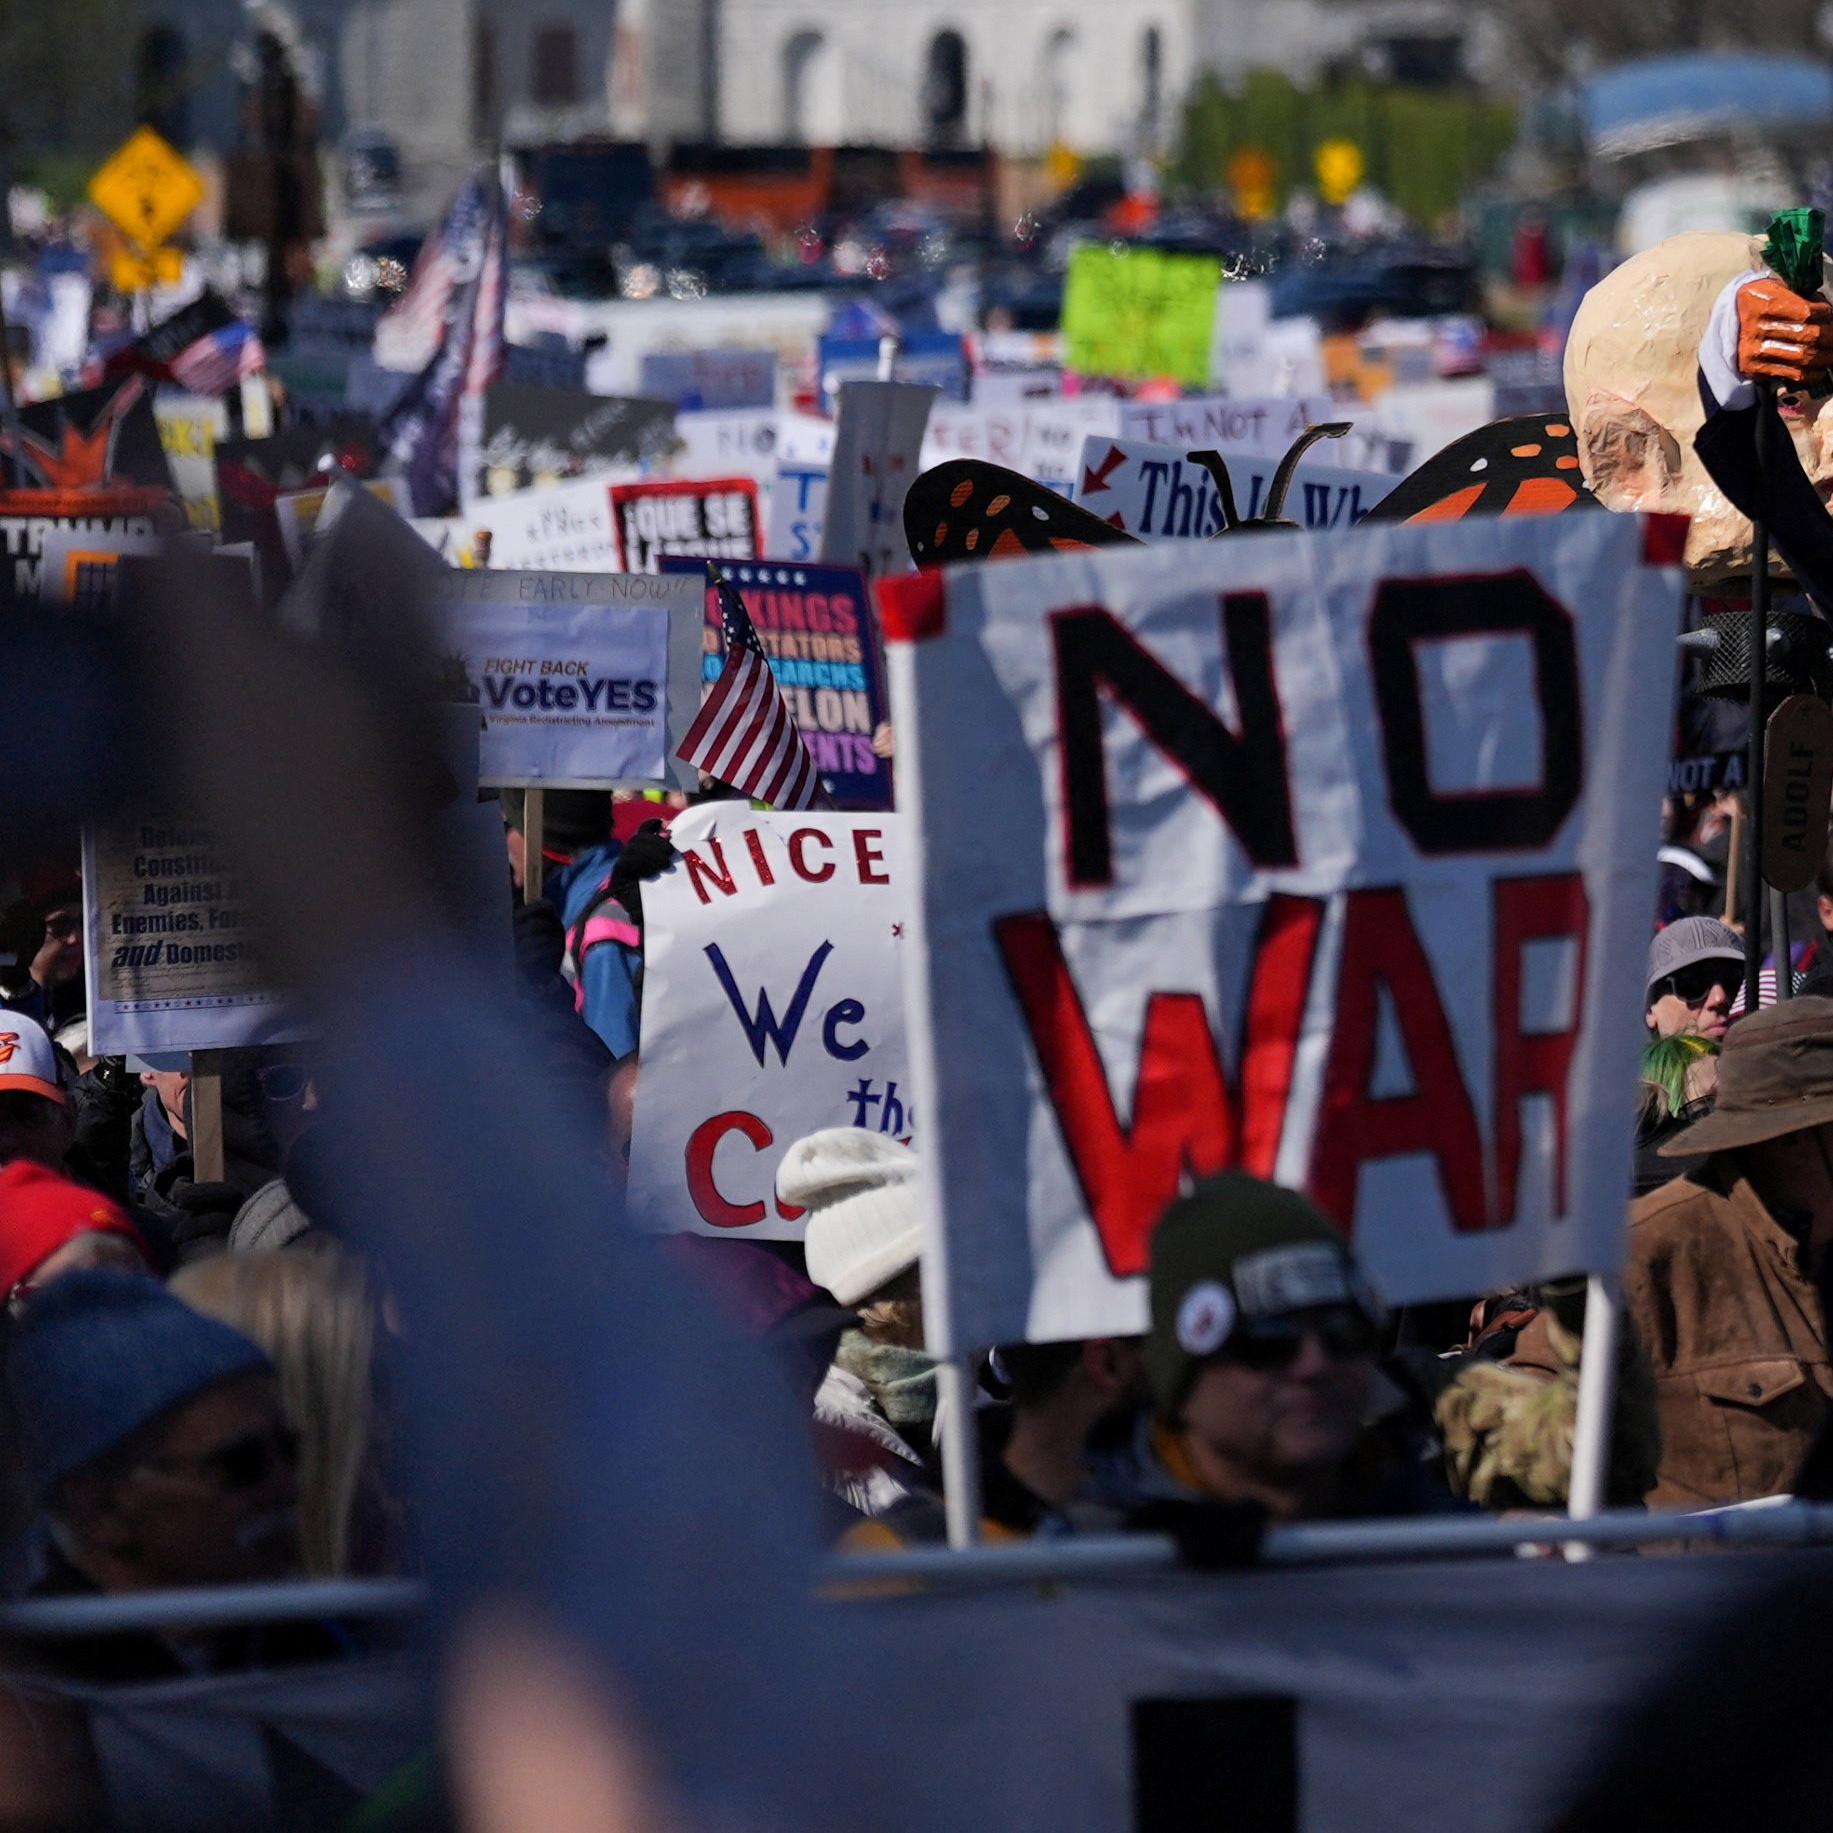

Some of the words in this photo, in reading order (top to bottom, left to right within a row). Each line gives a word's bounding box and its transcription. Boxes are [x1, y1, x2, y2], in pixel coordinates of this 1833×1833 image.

[1203, 404, 1268, 441] NOT
[703, 491, 749, 538] SE
[1138, 459, 1228, 537] This
[1303, 480, 1372, 531] Wh
[518, 577, 595, 602] EARLY
[740, 588, 860, 635] KINGS
[484, 658, 537, 675] FIGHT
[539, 660, 590, 677] BACK
[481, 675, 659, 713] VoteYES
[1049, 568, 1585, 892] NO
[1666, 756, 1722, 793] NOT
[1782, 742, 1815, 853] ADOLF
[682, 827, 891, 906] NICE
[112, 940, 164, 967] and
[165, 942, 247, 964] Domest
[702, 939, 870, 1068] We
[993, 872, 1592, 1278] WAR
